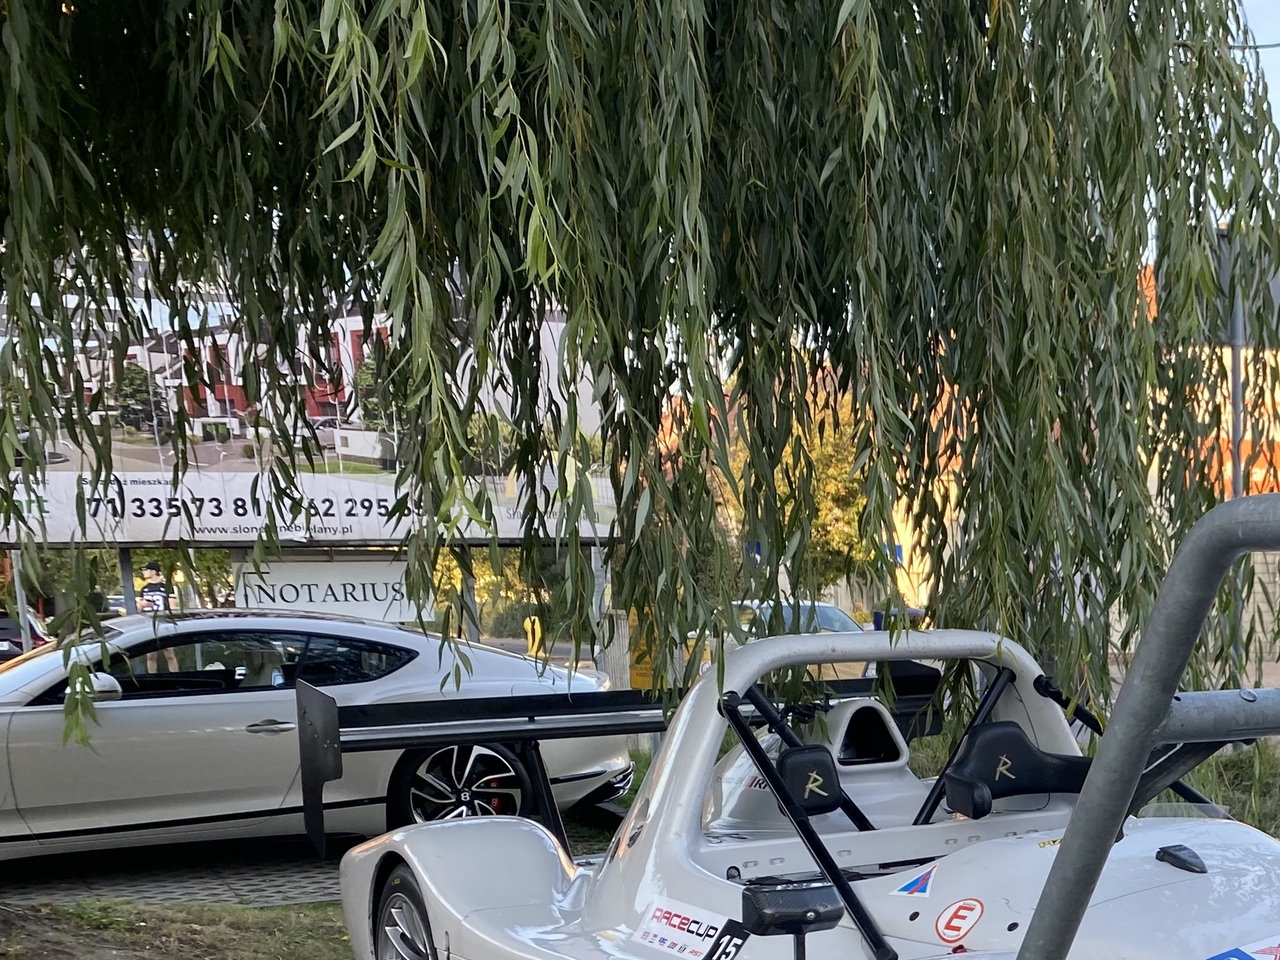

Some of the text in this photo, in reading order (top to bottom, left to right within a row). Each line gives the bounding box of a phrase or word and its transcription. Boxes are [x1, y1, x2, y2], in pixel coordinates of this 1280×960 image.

[131, 497, 181, 518] 335
[190, 497, 224, 518] 73
[345, 497, 389, 518] 295
[256, 581, 406, 604] NOTARIUS
[994, 754, 1016, 781] R
[804, 770, 829, 799] R
[943, 905, 976, 932] E
